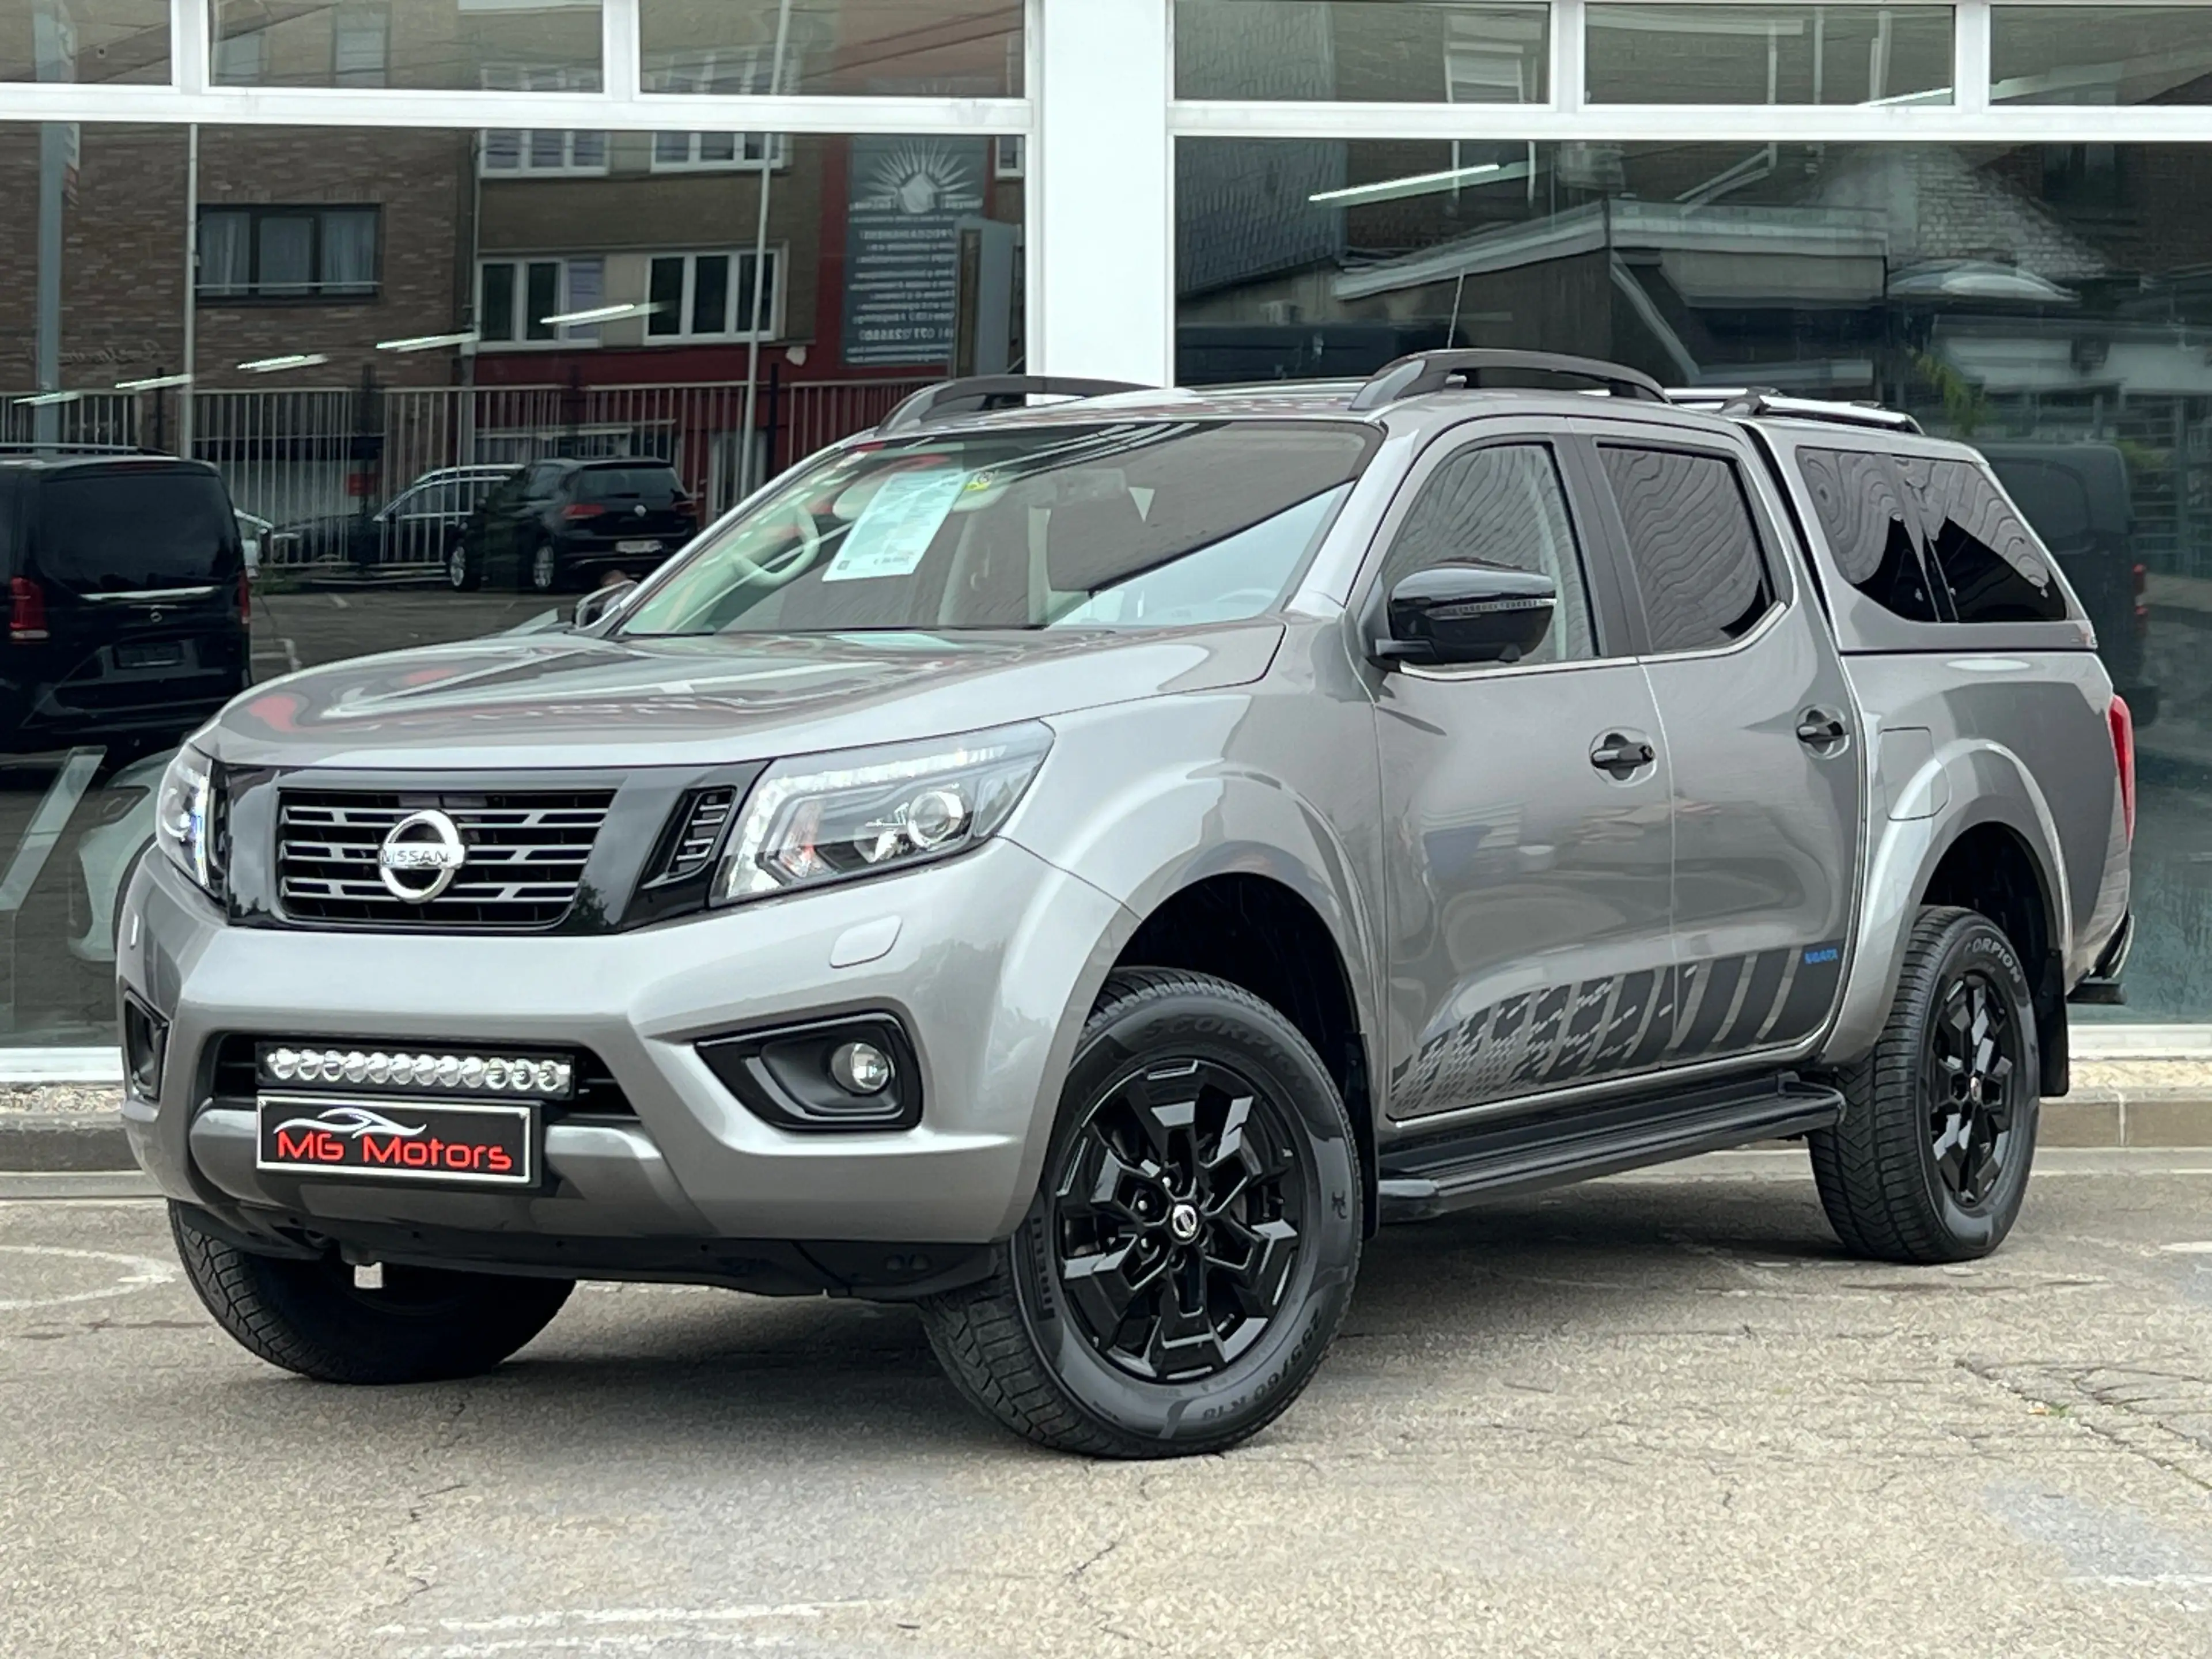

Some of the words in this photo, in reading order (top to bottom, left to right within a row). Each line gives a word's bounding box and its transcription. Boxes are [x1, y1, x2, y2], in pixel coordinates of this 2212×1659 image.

[380, 850, 451, 865] NISSAN
[278, 1130, 344, 1160] MG
[362, 1134, 512, 1171] Motors
